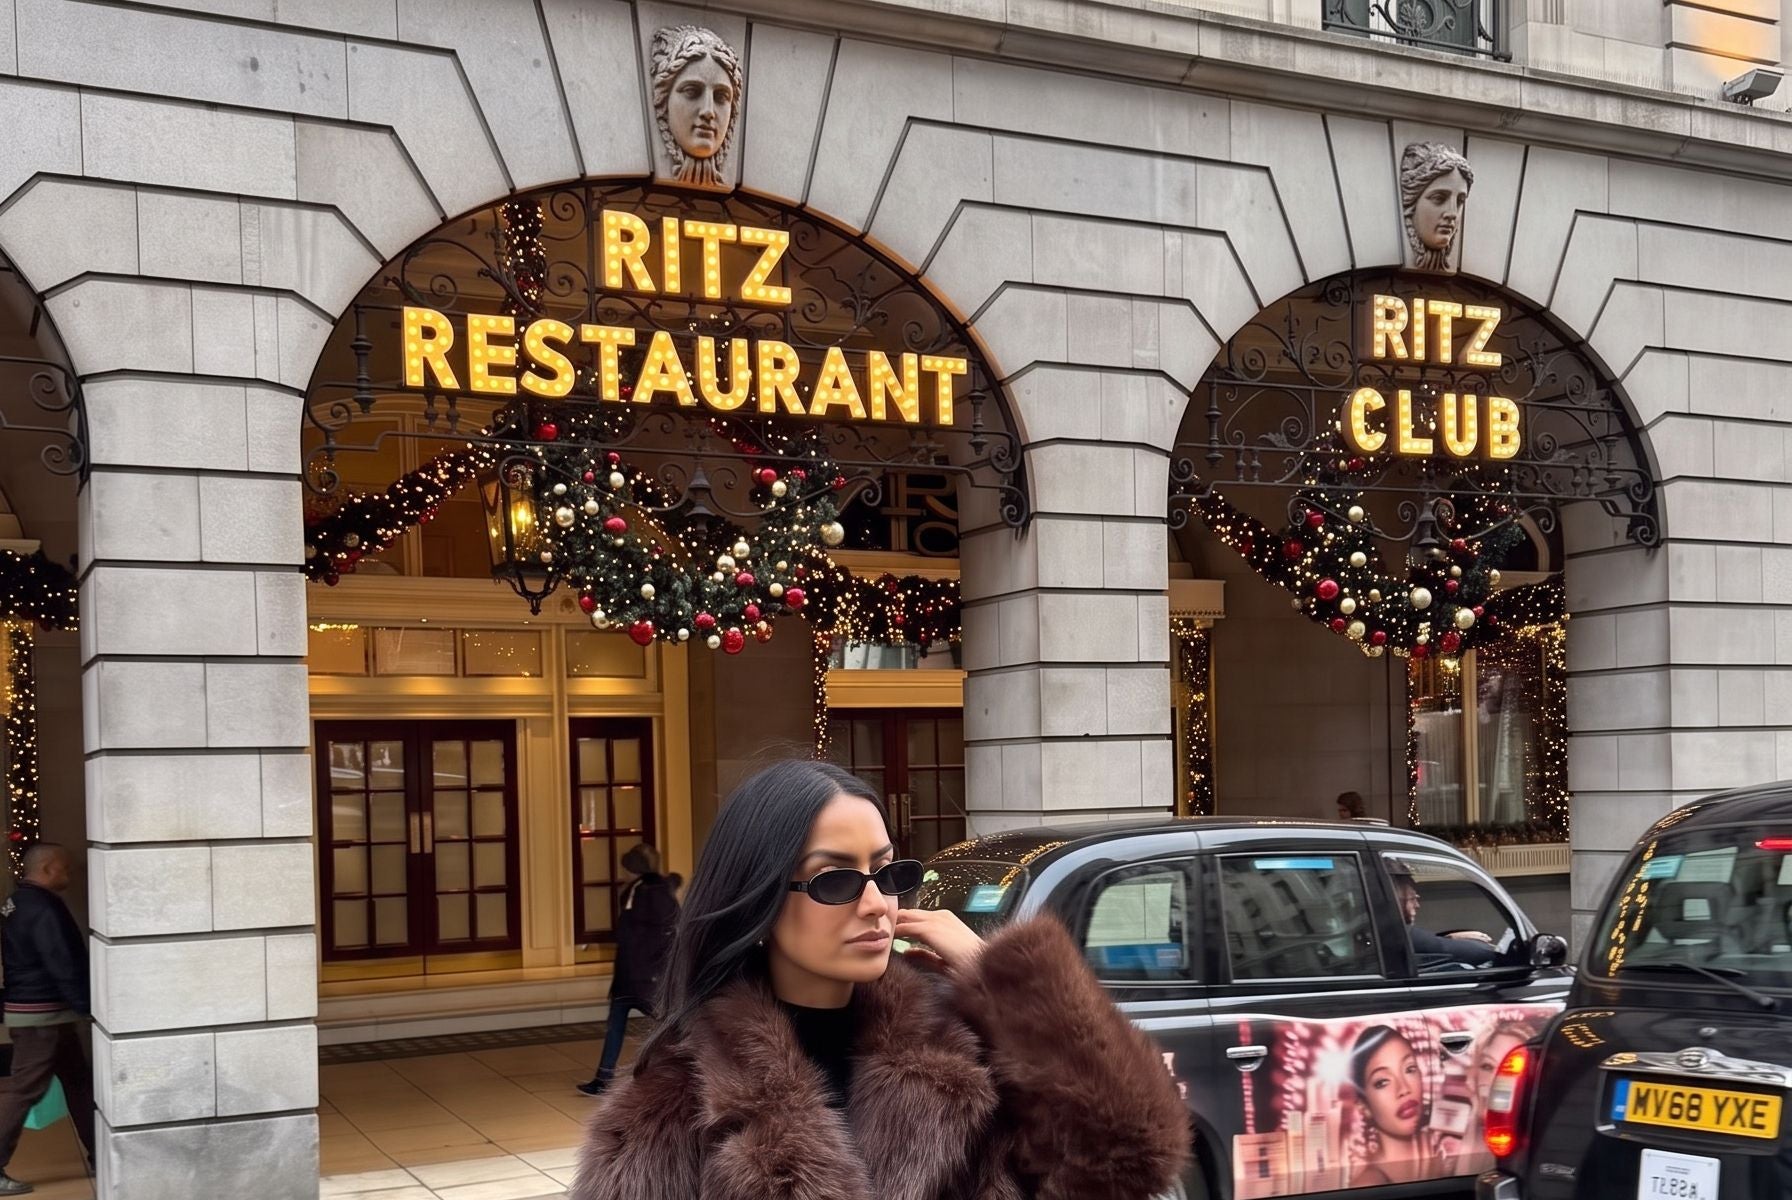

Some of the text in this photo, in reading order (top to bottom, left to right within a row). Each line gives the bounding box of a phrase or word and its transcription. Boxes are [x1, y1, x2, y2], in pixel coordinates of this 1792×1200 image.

[602, 210, 792, 304] RITZ
[403, 306, 967, 425] RESTAURANT
[1373, 294, 1502, 366] RITZ
[1350, 387, 1521, 459] CLUB
[1713, 1095, 1770, 1130] YXE
